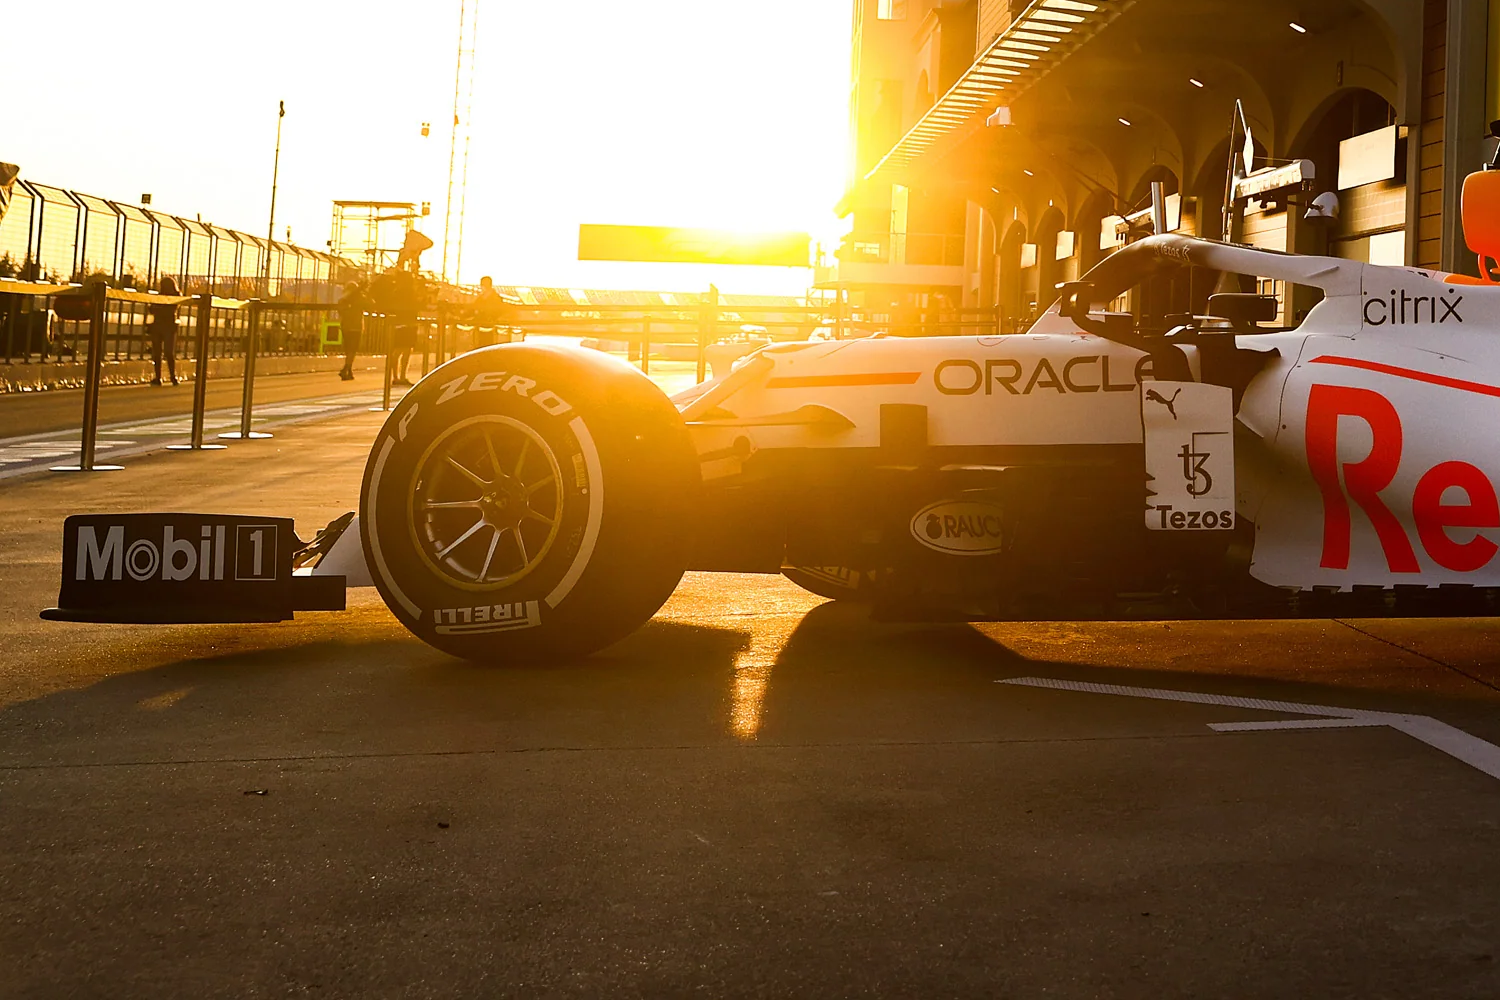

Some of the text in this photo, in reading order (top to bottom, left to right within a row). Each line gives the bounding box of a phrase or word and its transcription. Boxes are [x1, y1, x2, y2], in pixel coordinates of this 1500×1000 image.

[1363, 289, 1463, 326] citrix
[399, 371, 572, 442] P ZERO
[1155, 504, 1233, 529] Tezos
[75, 525, 226, 581] Mobil
[434, 600, 541, 635] PIRELLI
